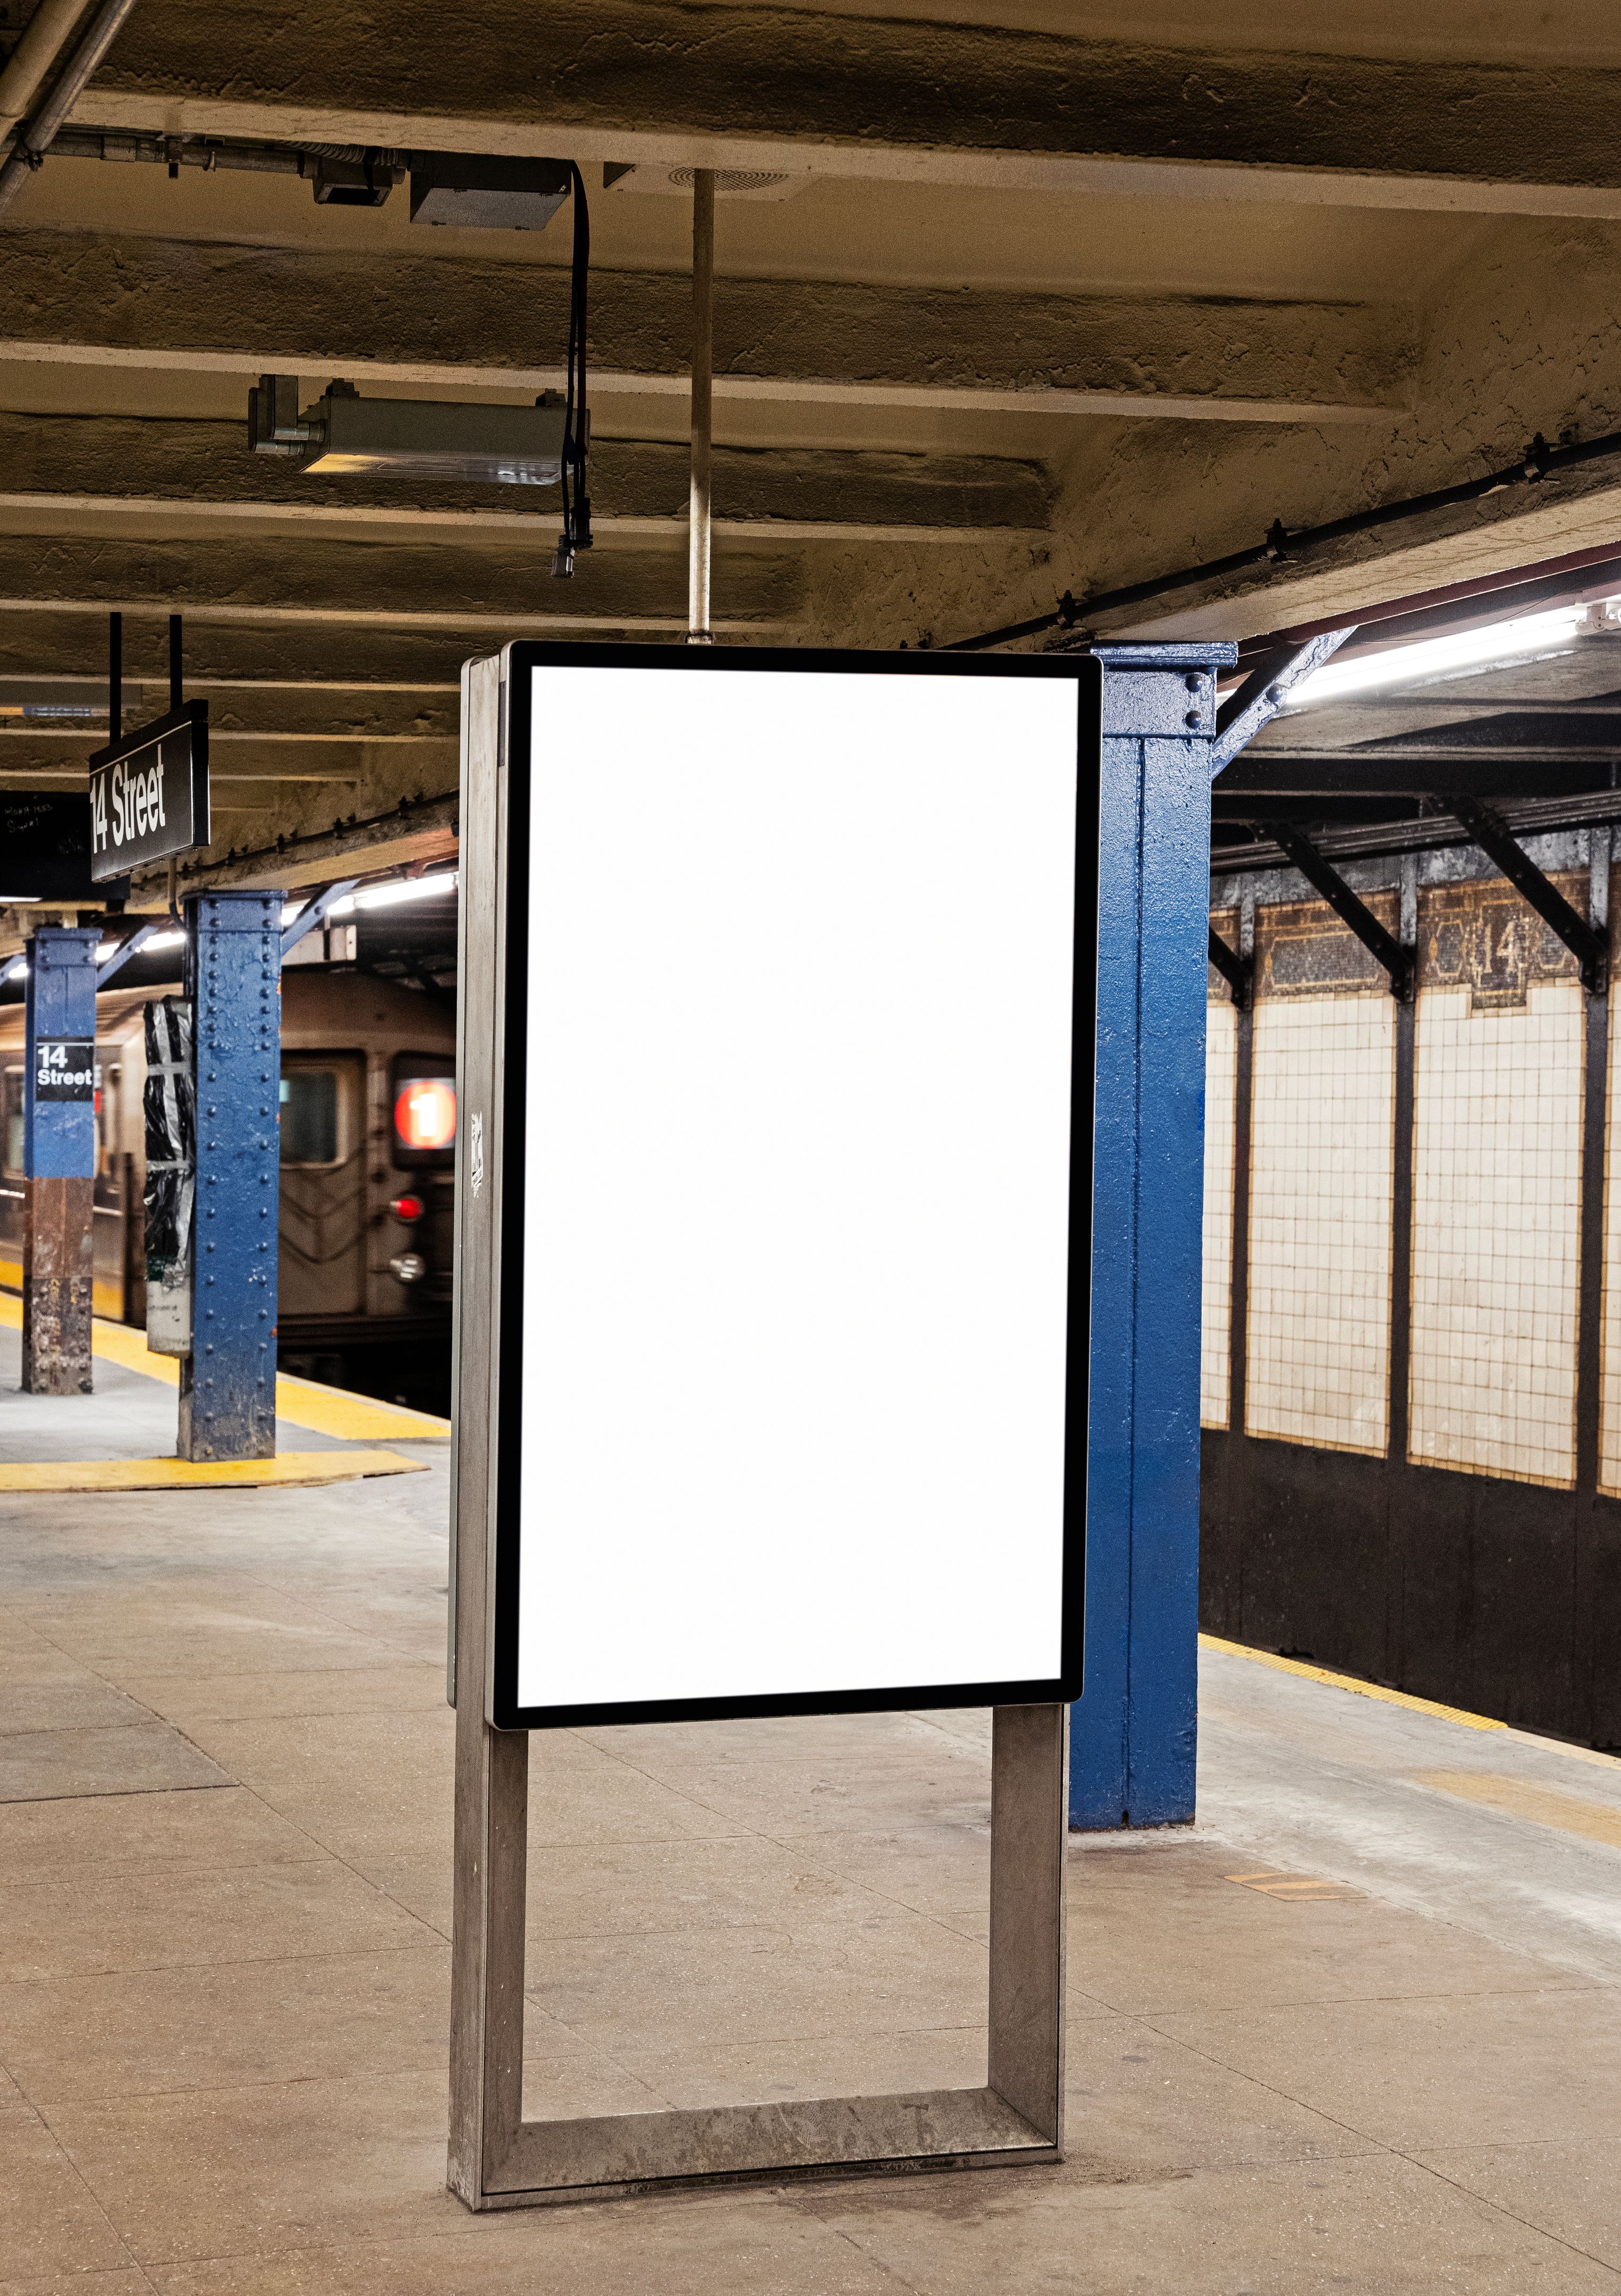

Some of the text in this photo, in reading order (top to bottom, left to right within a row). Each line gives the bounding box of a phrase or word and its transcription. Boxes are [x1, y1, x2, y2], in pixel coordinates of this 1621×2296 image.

[90, 744, 165, 854] 14 Street
[1484, 921, 1518, 973] 14
[37, 1069, 92, 1085] Street
[38, 1045, 68, 1068] 14
[409, 1093, 437, 1137] 1
